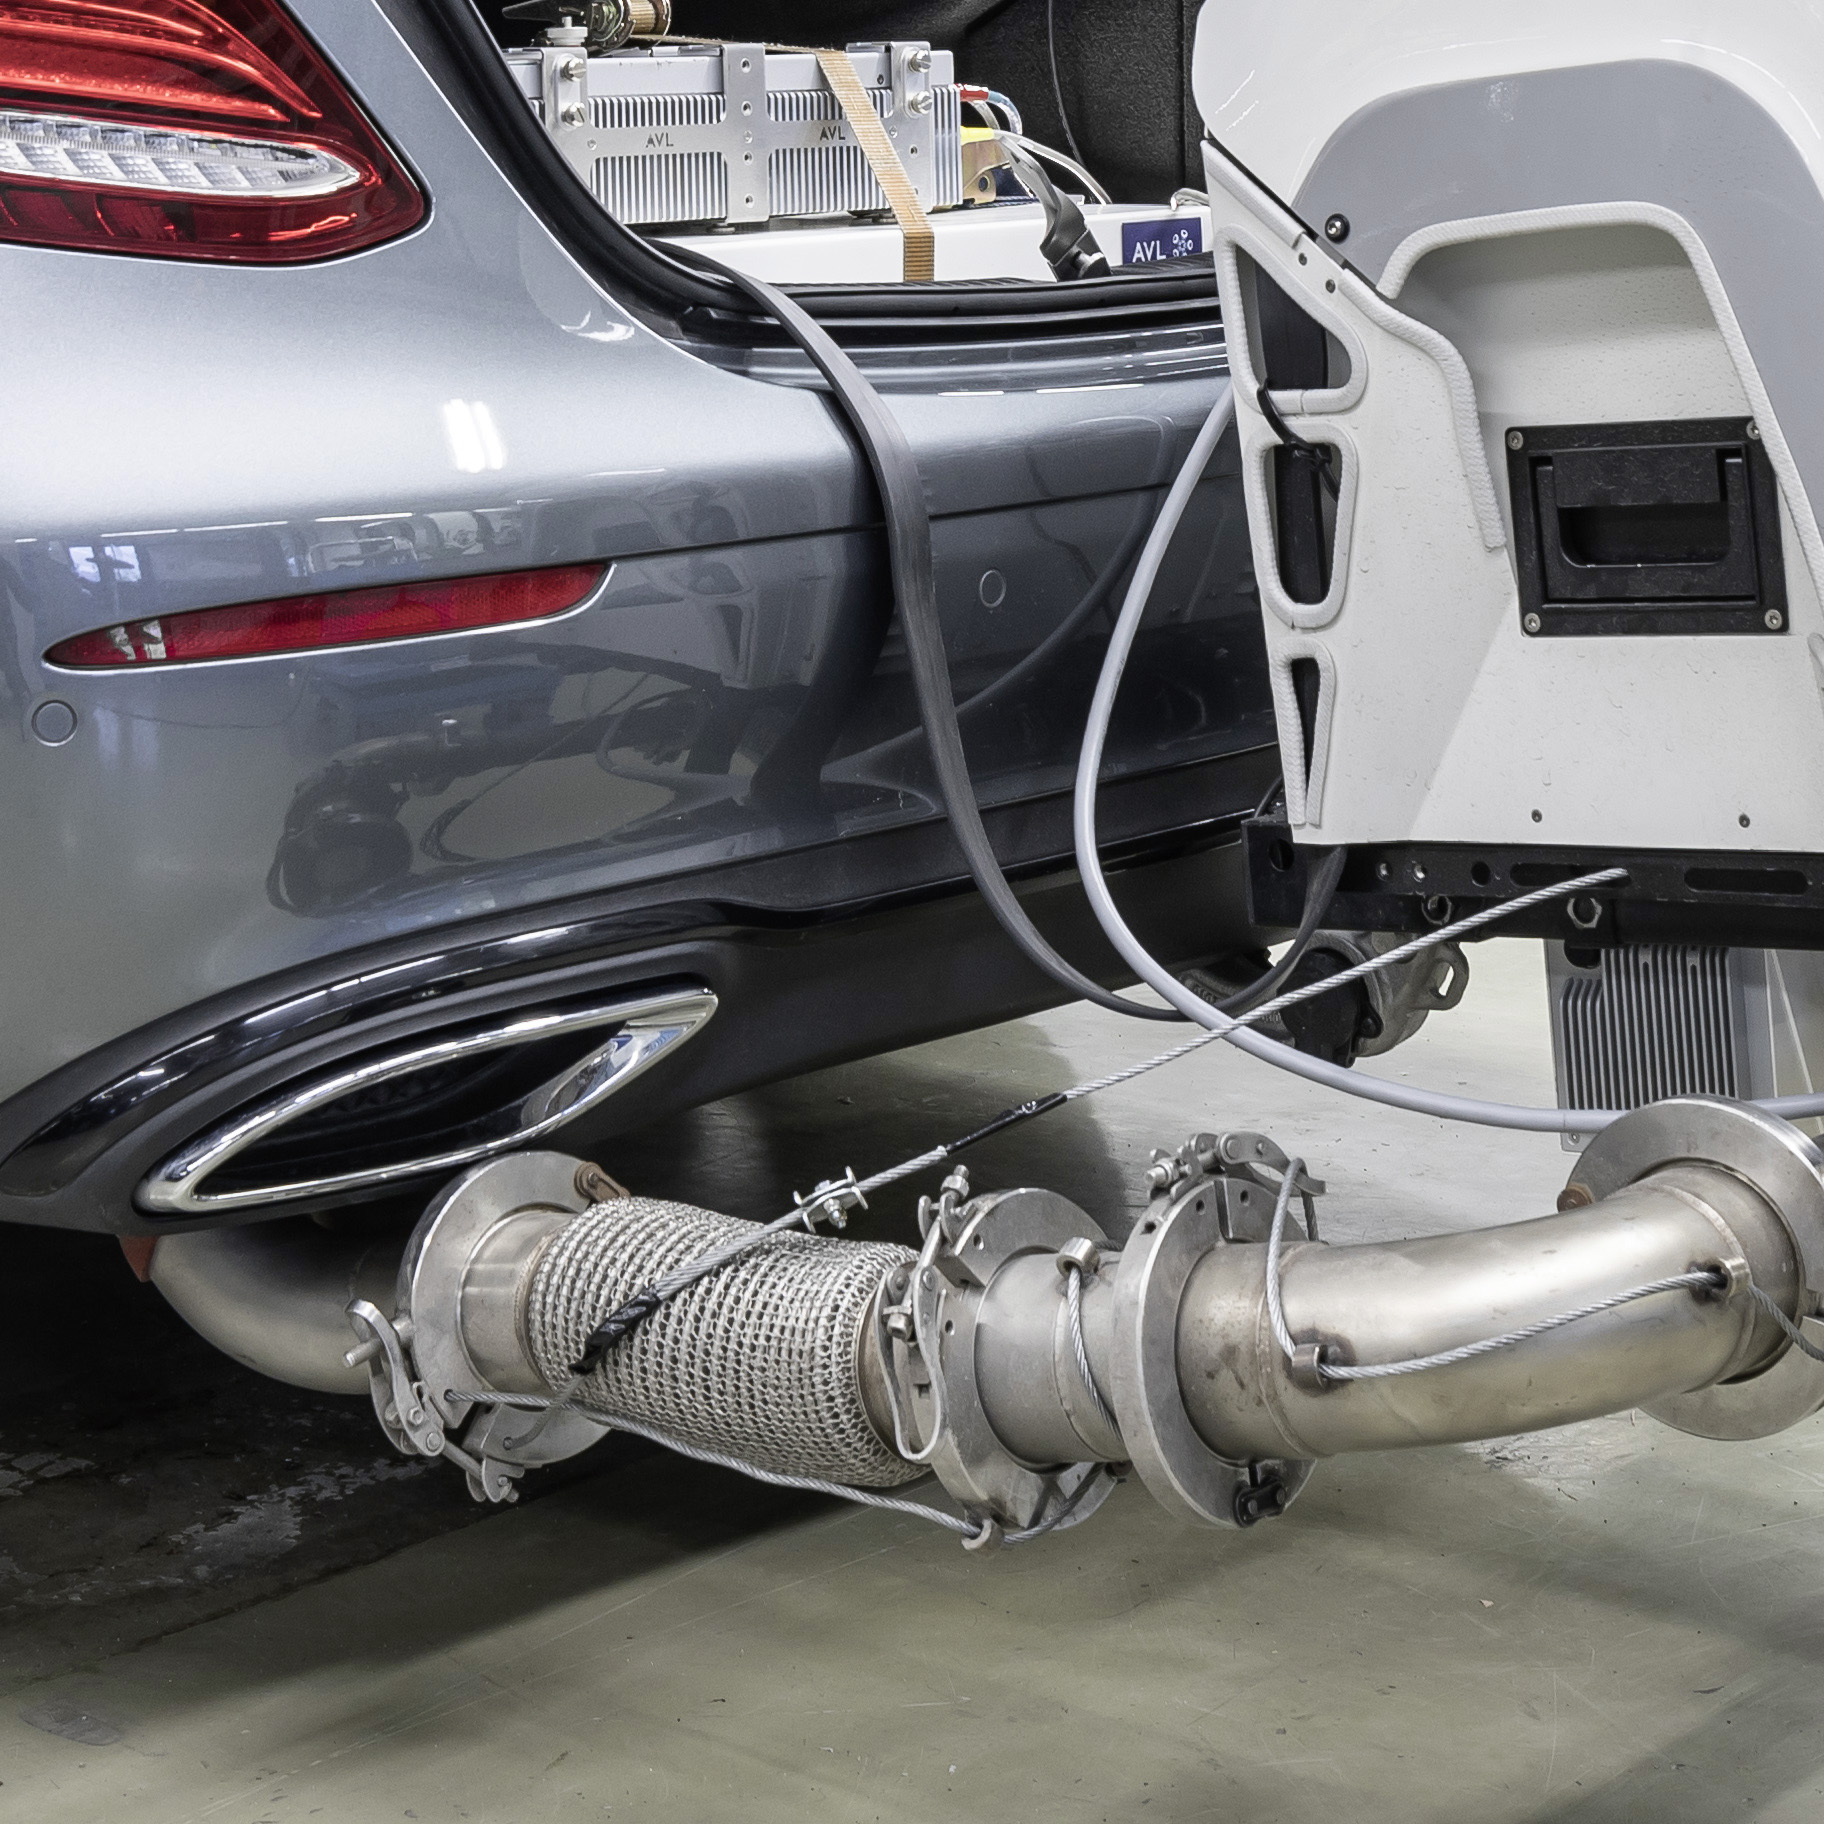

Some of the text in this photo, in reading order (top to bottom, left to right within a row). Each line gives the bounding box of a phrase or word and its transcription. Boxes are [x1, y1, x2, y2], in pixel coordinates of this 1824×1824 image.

[645, 132, 674, 148] AVL
[819, 126, 846, 141] AVL
[1132, 240, 1167, 263] AVL
